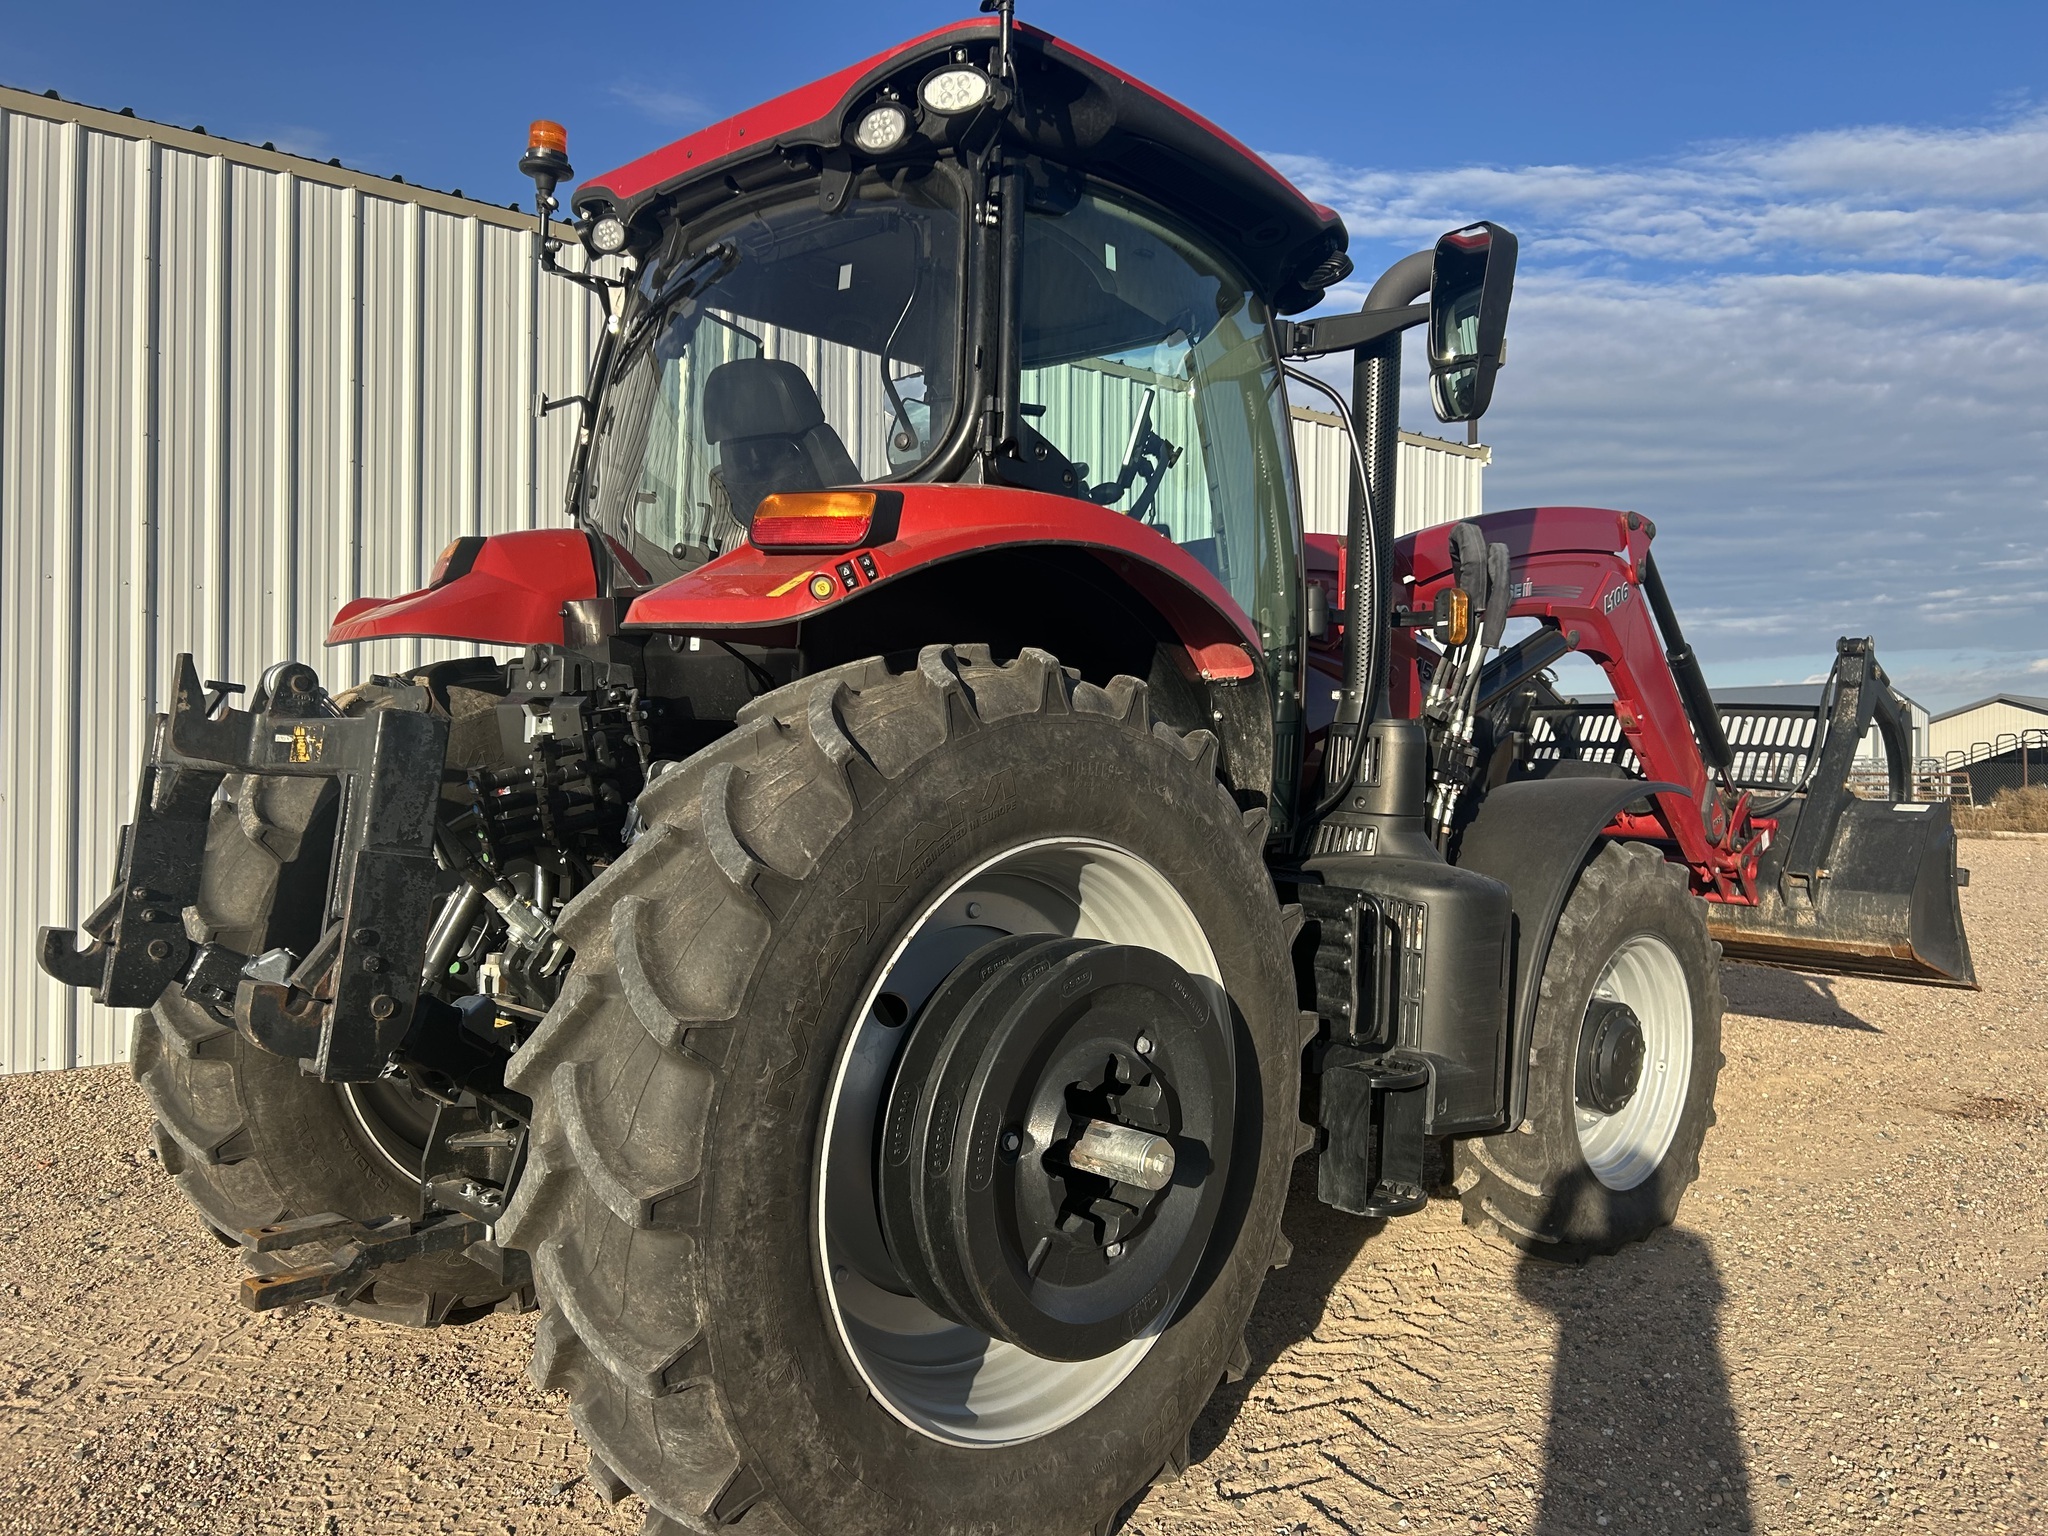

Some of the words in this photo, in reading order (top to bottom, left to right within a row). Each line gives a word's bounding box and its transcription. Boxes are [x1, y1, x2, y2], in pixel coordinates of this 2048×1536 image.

[1603, 580, 1630, 616] L106
[913, 826, 967, 879] ENGINEERED
[969, 816, 982, 832] IN
[981, 800, 1017, 824] EUROPE
[764, 767, 1018, 1112] MAXAM
[338, 1127, 390, 1194] RADIAL
